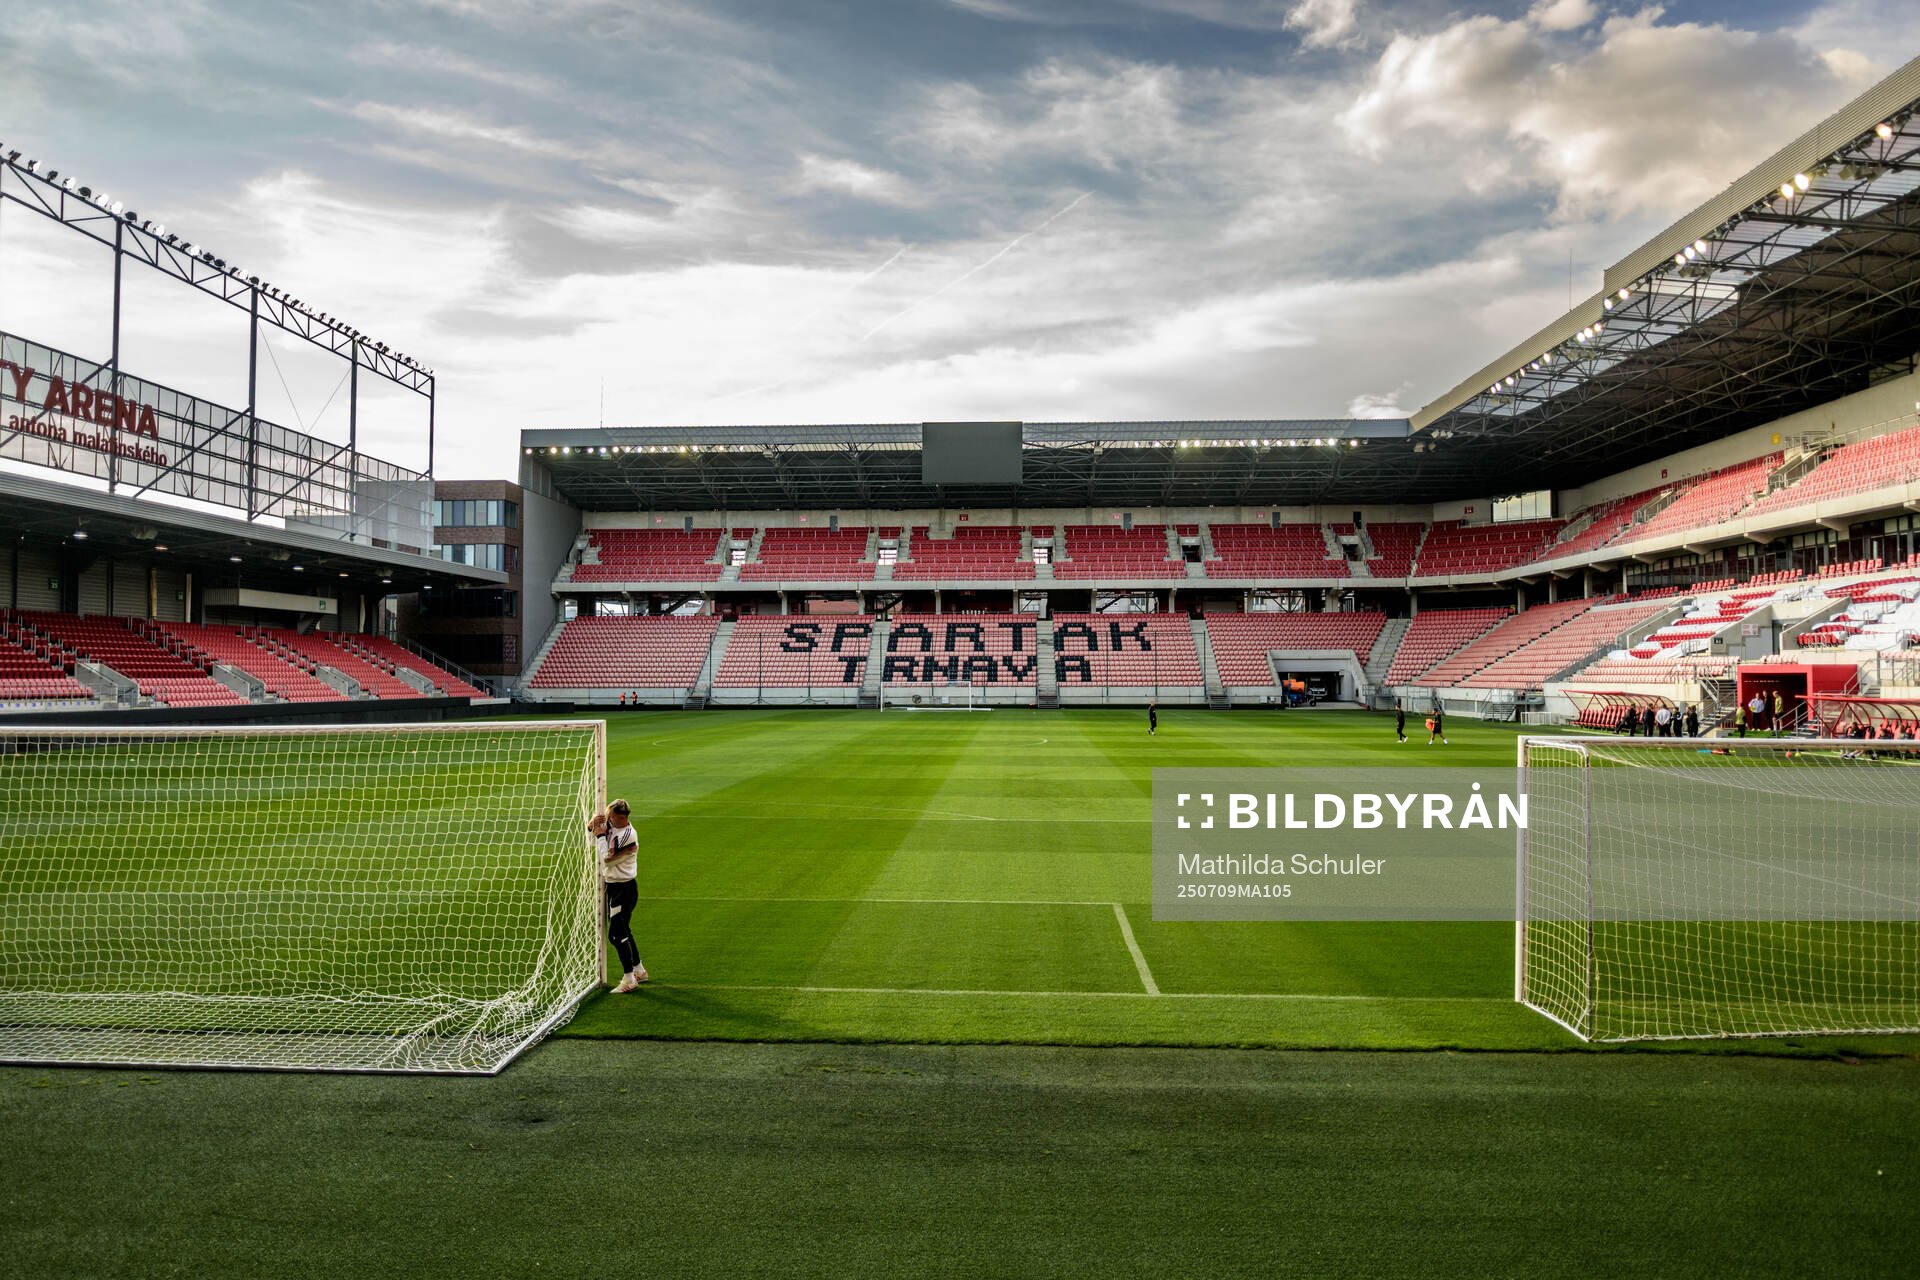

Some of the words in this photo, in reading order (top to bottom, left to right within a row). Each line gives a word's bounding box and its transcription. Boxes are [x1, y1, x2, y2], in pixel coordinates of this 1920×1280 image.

[43, 374, 159, 441] ARENA
[8, 414, 68, 442] antona
[72, 430, 168, 467] malatinského
[779, 622, 1153, 653] SPARTAK
[837, 655, 1093, 684] TRNAVA
